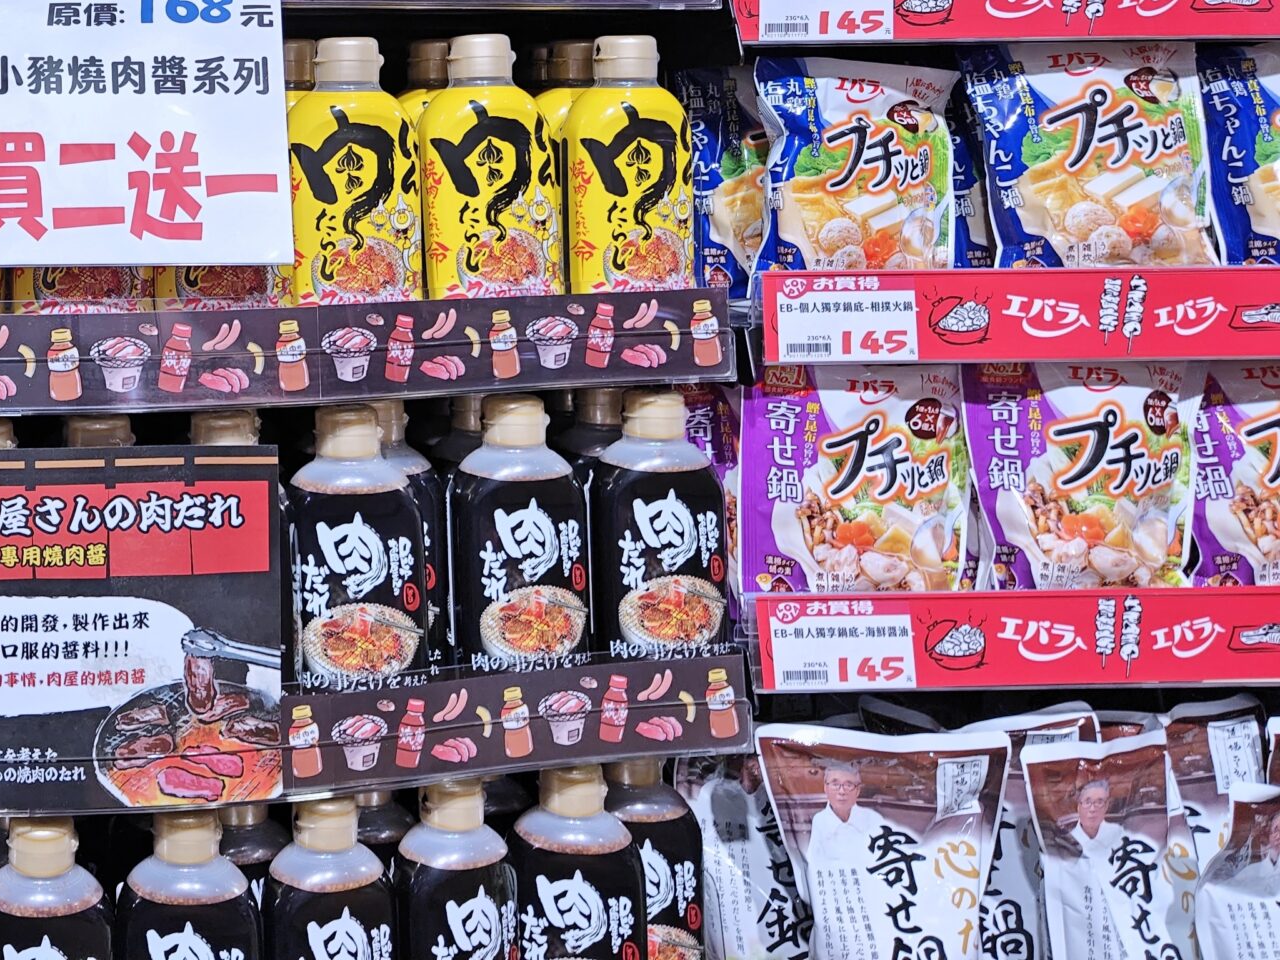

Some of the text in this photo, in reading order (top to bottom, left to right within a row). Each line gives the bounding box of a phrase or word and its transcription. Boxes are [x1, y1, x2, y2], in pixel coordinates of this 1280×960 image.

[47, 1, 125, 27] 原價:
[240, 3, 274, 28] 元
[819, 10, 885, 35] 145
[1047, 53, 1111, 76] エバラ
[1048, 89, 1185, 168] プチッと鍋
[1199, 69, 1255, 206] 塩ちゃんこ鍋
[813, 276, 880, 290] お買得
[780, 301, 914, 313] EB-個人獨享鍋底-相撲火鍋
[1002, 294, 1091, 338] エバラ
[842, 330, 908, 355] 145
[846, 379, 898, 405] エバラ
[766, 402, 803, 503] 寄せ鍋
[825, 419, 945, 496] プチッと鍋
[986, 392, 1025, 491] 寄せ鍋
[1053, 409, 1179, 491] プチッと鍋
[632, 489, 698, 572] 肉
[618, 530, 651, 592] だれ
[806, 600, 873, 615] お買得
[774, 626, 909, 639] EB-個人獨享鍋底-海鮮醬油
[1150, 616, 1226, 658] エバラ
[838, 656, 904, 682] 145
